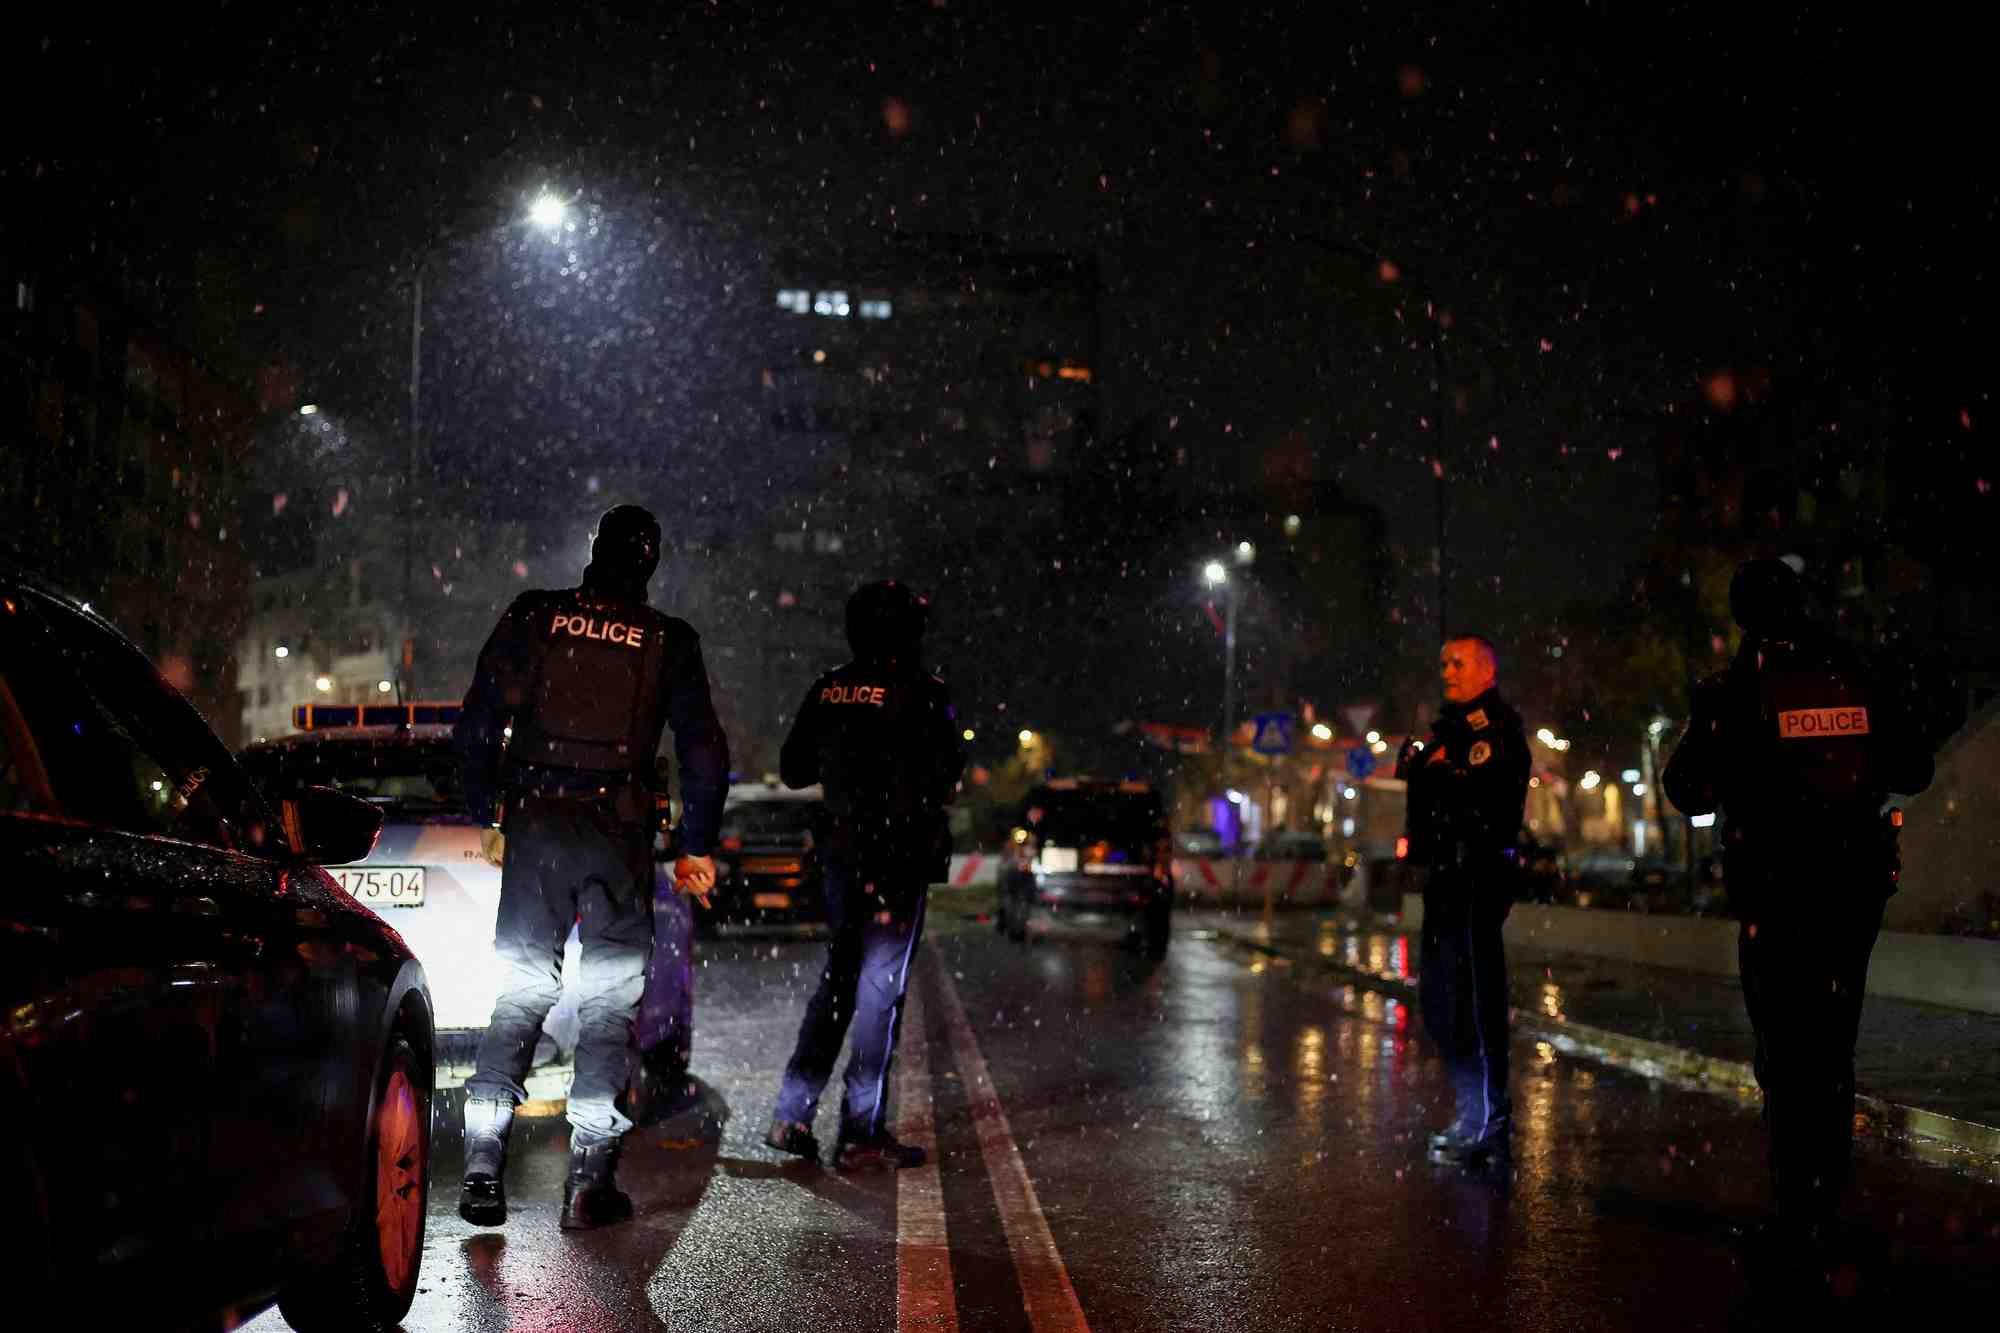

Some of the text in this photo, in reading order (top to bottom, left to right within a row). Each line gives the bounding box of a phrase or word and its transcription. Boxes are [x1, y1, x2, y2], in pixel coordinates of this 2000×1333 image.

[551, 615, 644, 648] POLICE
[820, 686, 885, 704] POLICE
[1787, 711, 1864, 733] POLICE
[339, 872, 419, 897] 175-04
